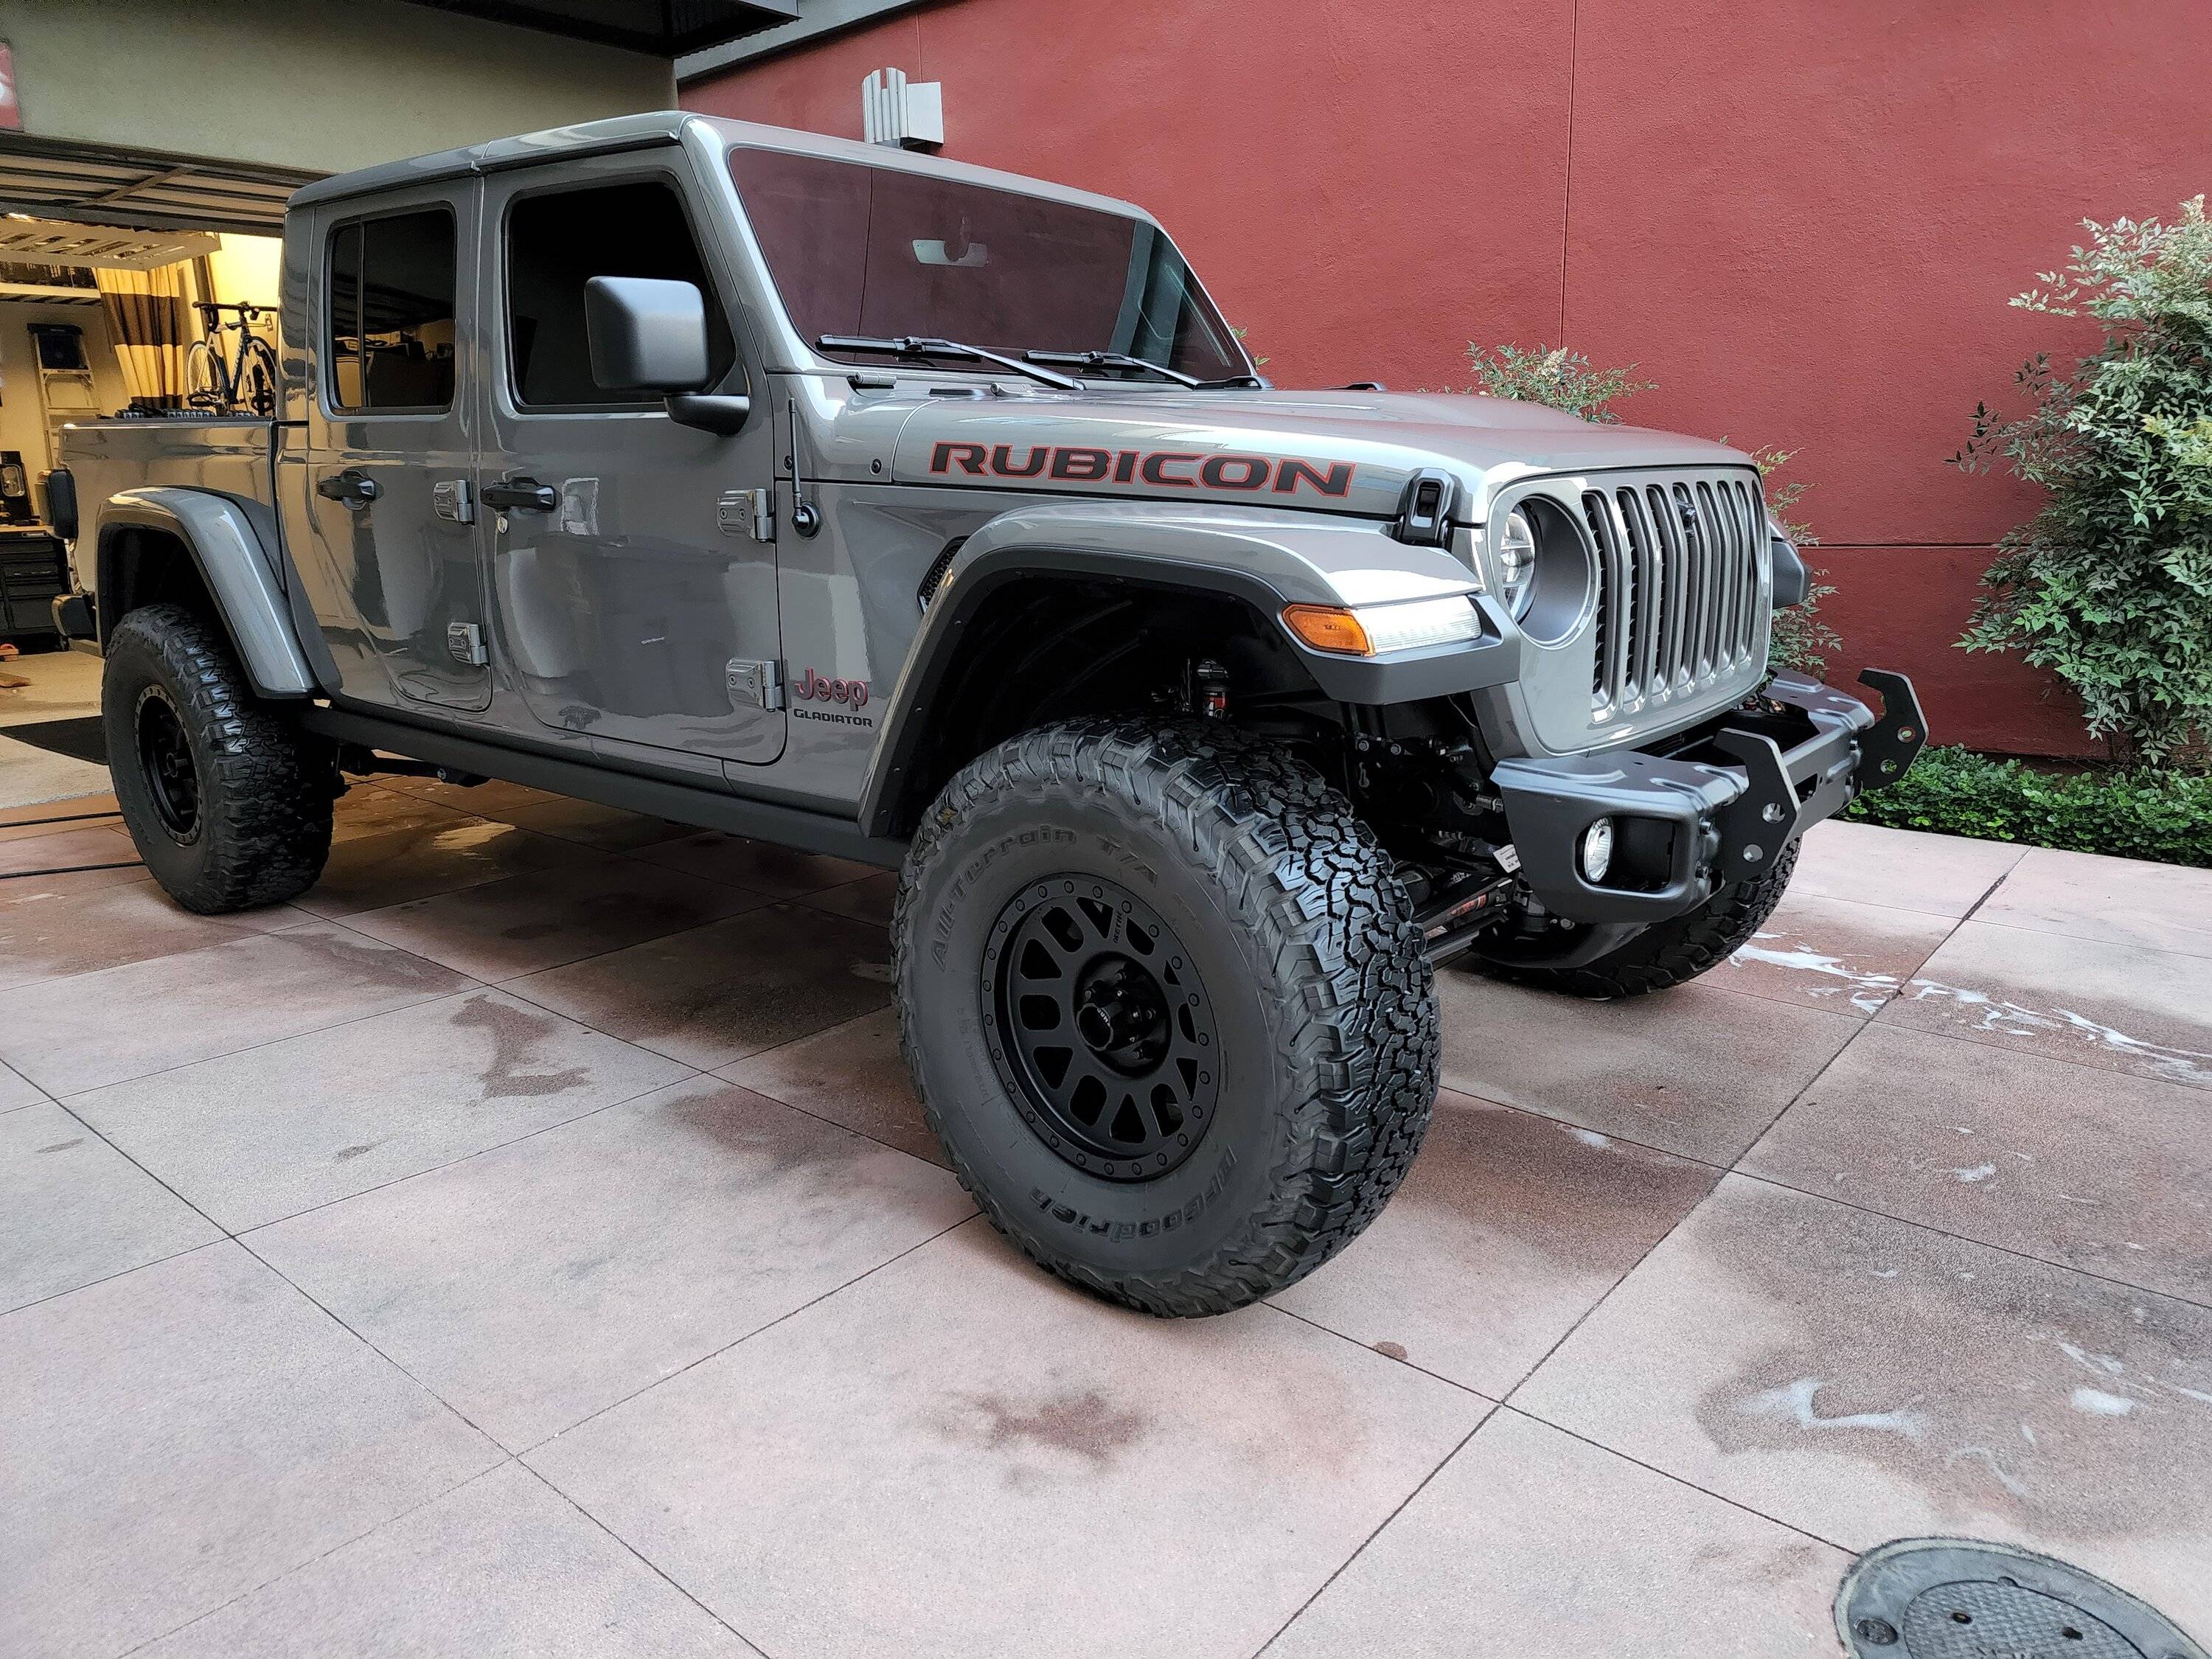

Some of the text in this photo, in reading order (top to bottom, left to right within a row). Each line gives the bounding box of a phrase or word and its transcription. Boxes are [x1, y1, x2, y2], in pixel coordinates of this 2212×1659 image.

[929, 441, 1357, 498] RUBICON
[794, 667, 869, 712] Jeep
[793, 709, 873, 727] GLADIATOR
